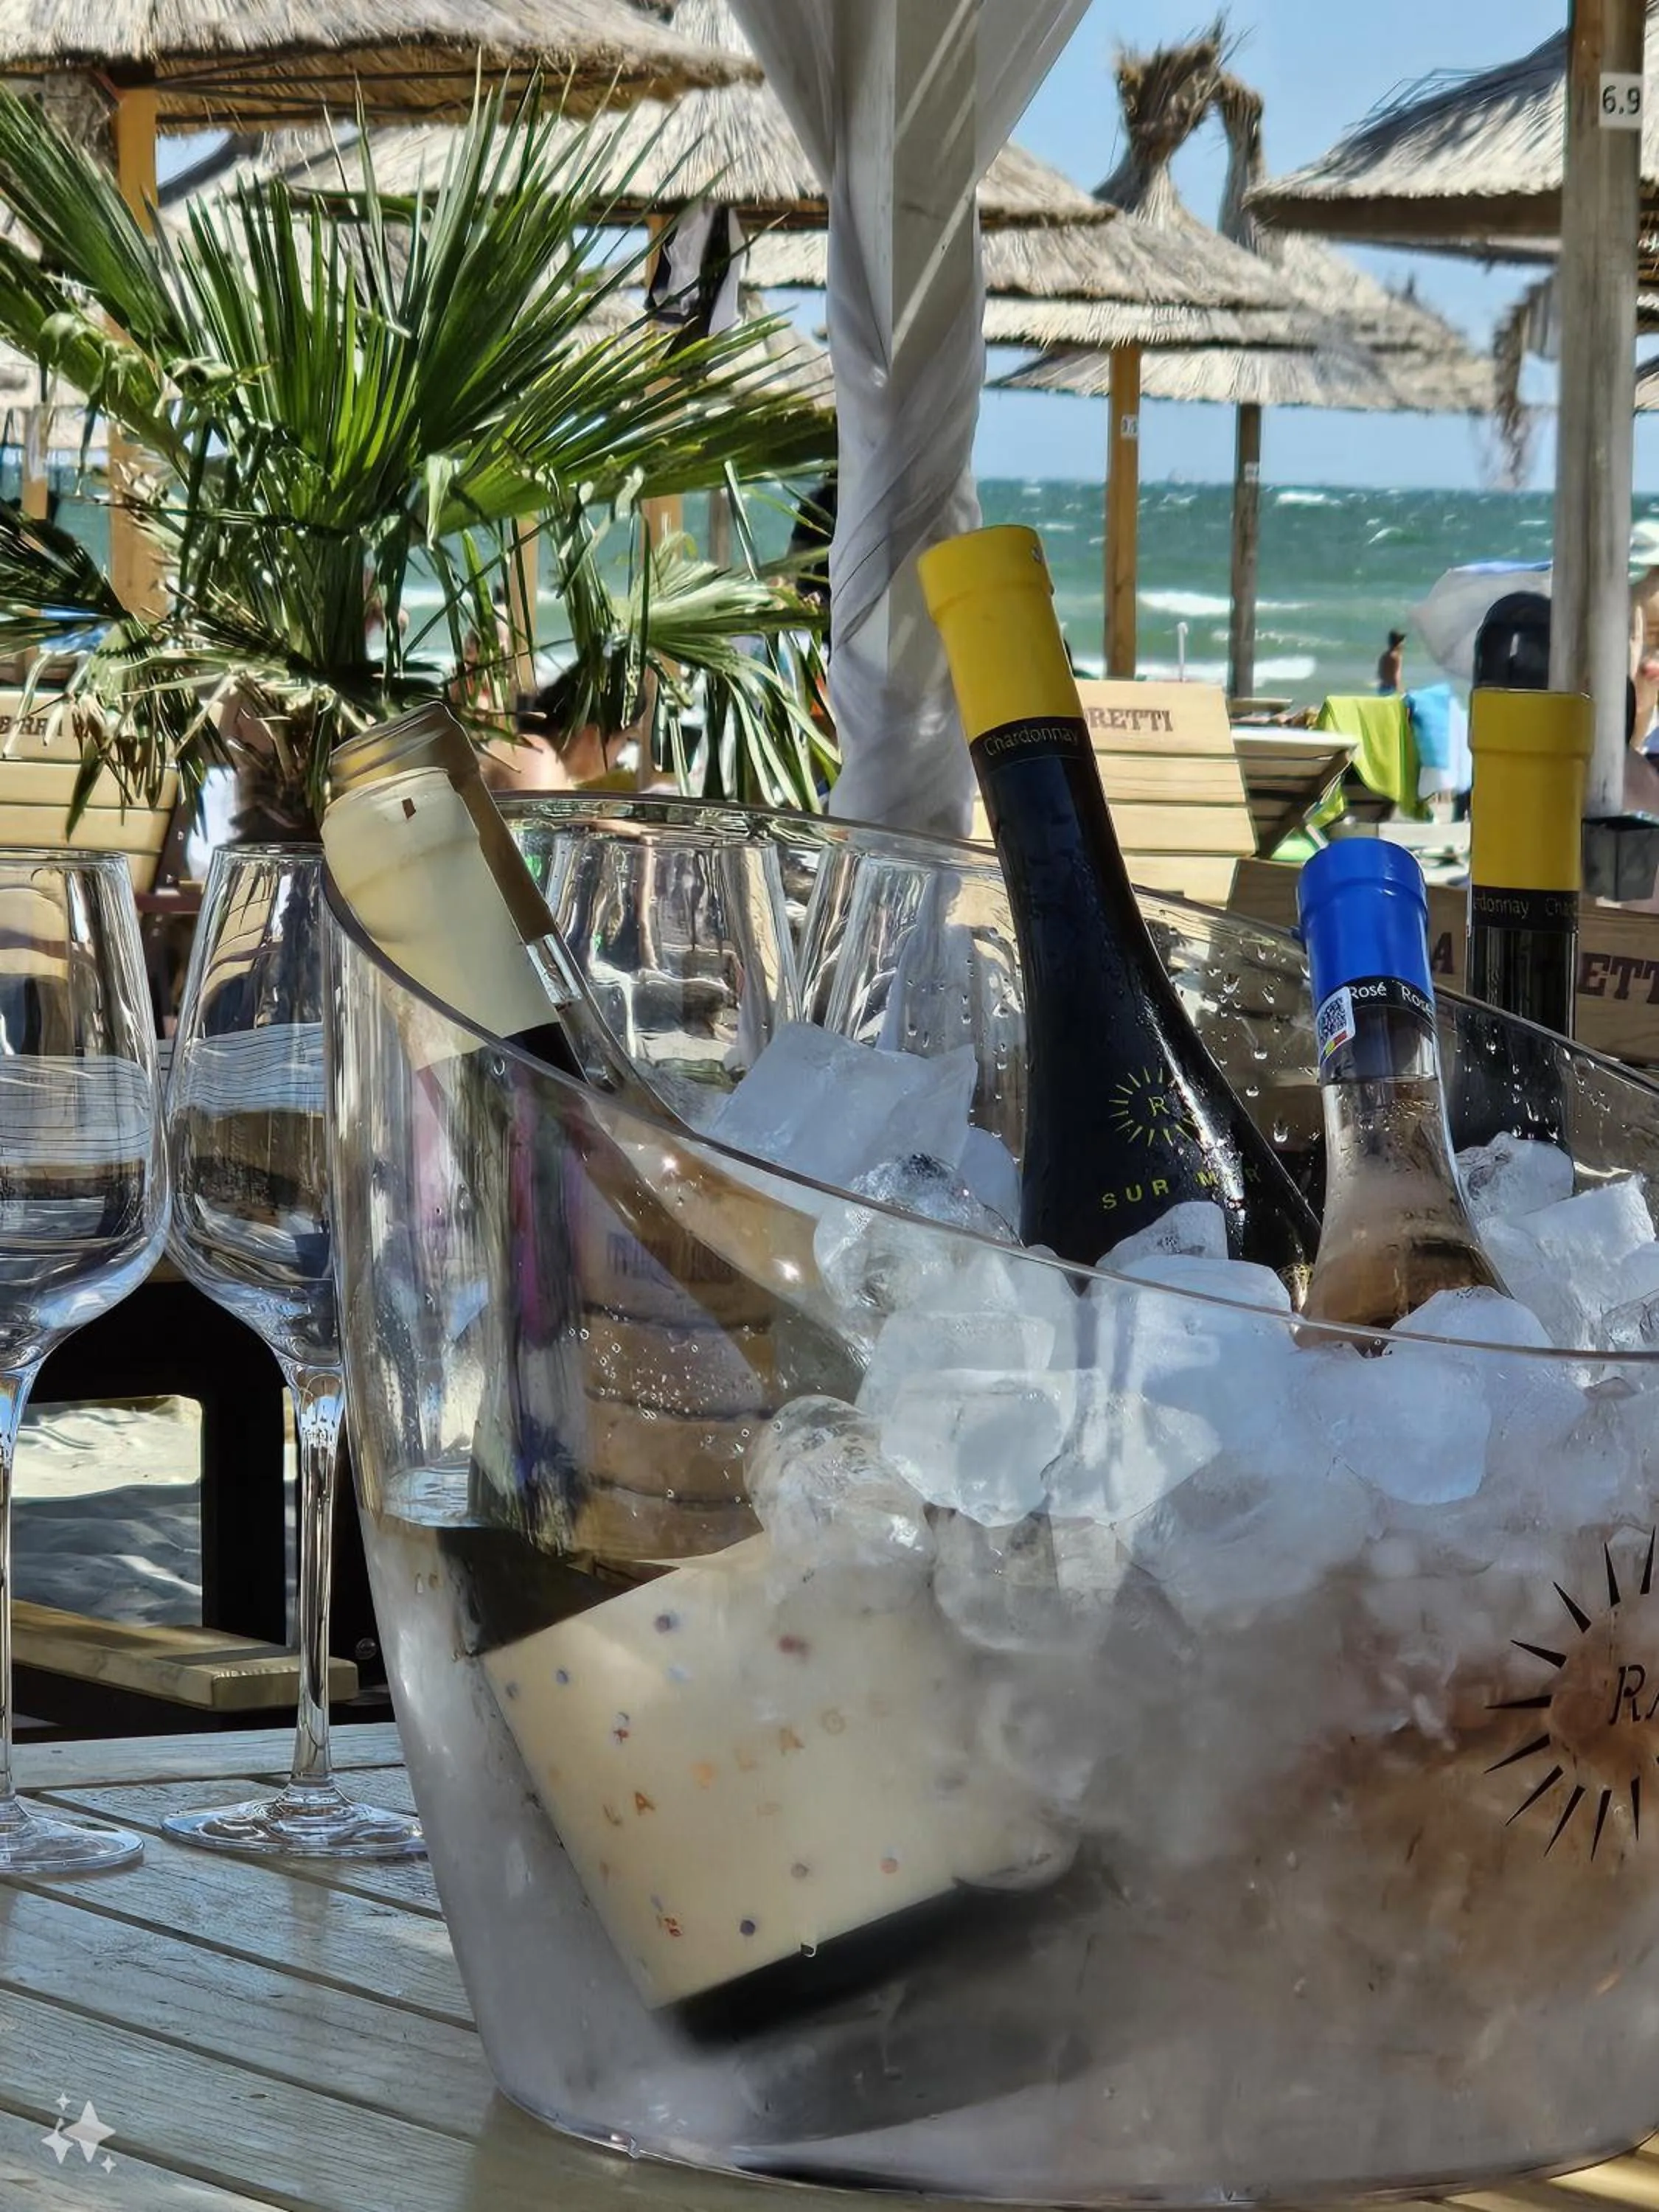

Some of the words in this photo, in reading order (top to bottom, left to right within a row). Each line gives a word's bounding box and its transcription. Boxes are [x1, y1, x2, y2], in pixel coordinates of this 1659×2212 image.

[1602, 85, 1641, 114] 6.9
[984, 726, 1079, 756] Chardonnay
[1350, 981, 1387, 999] Rosé
[1102, 1179, 1169, 1210] SUR
